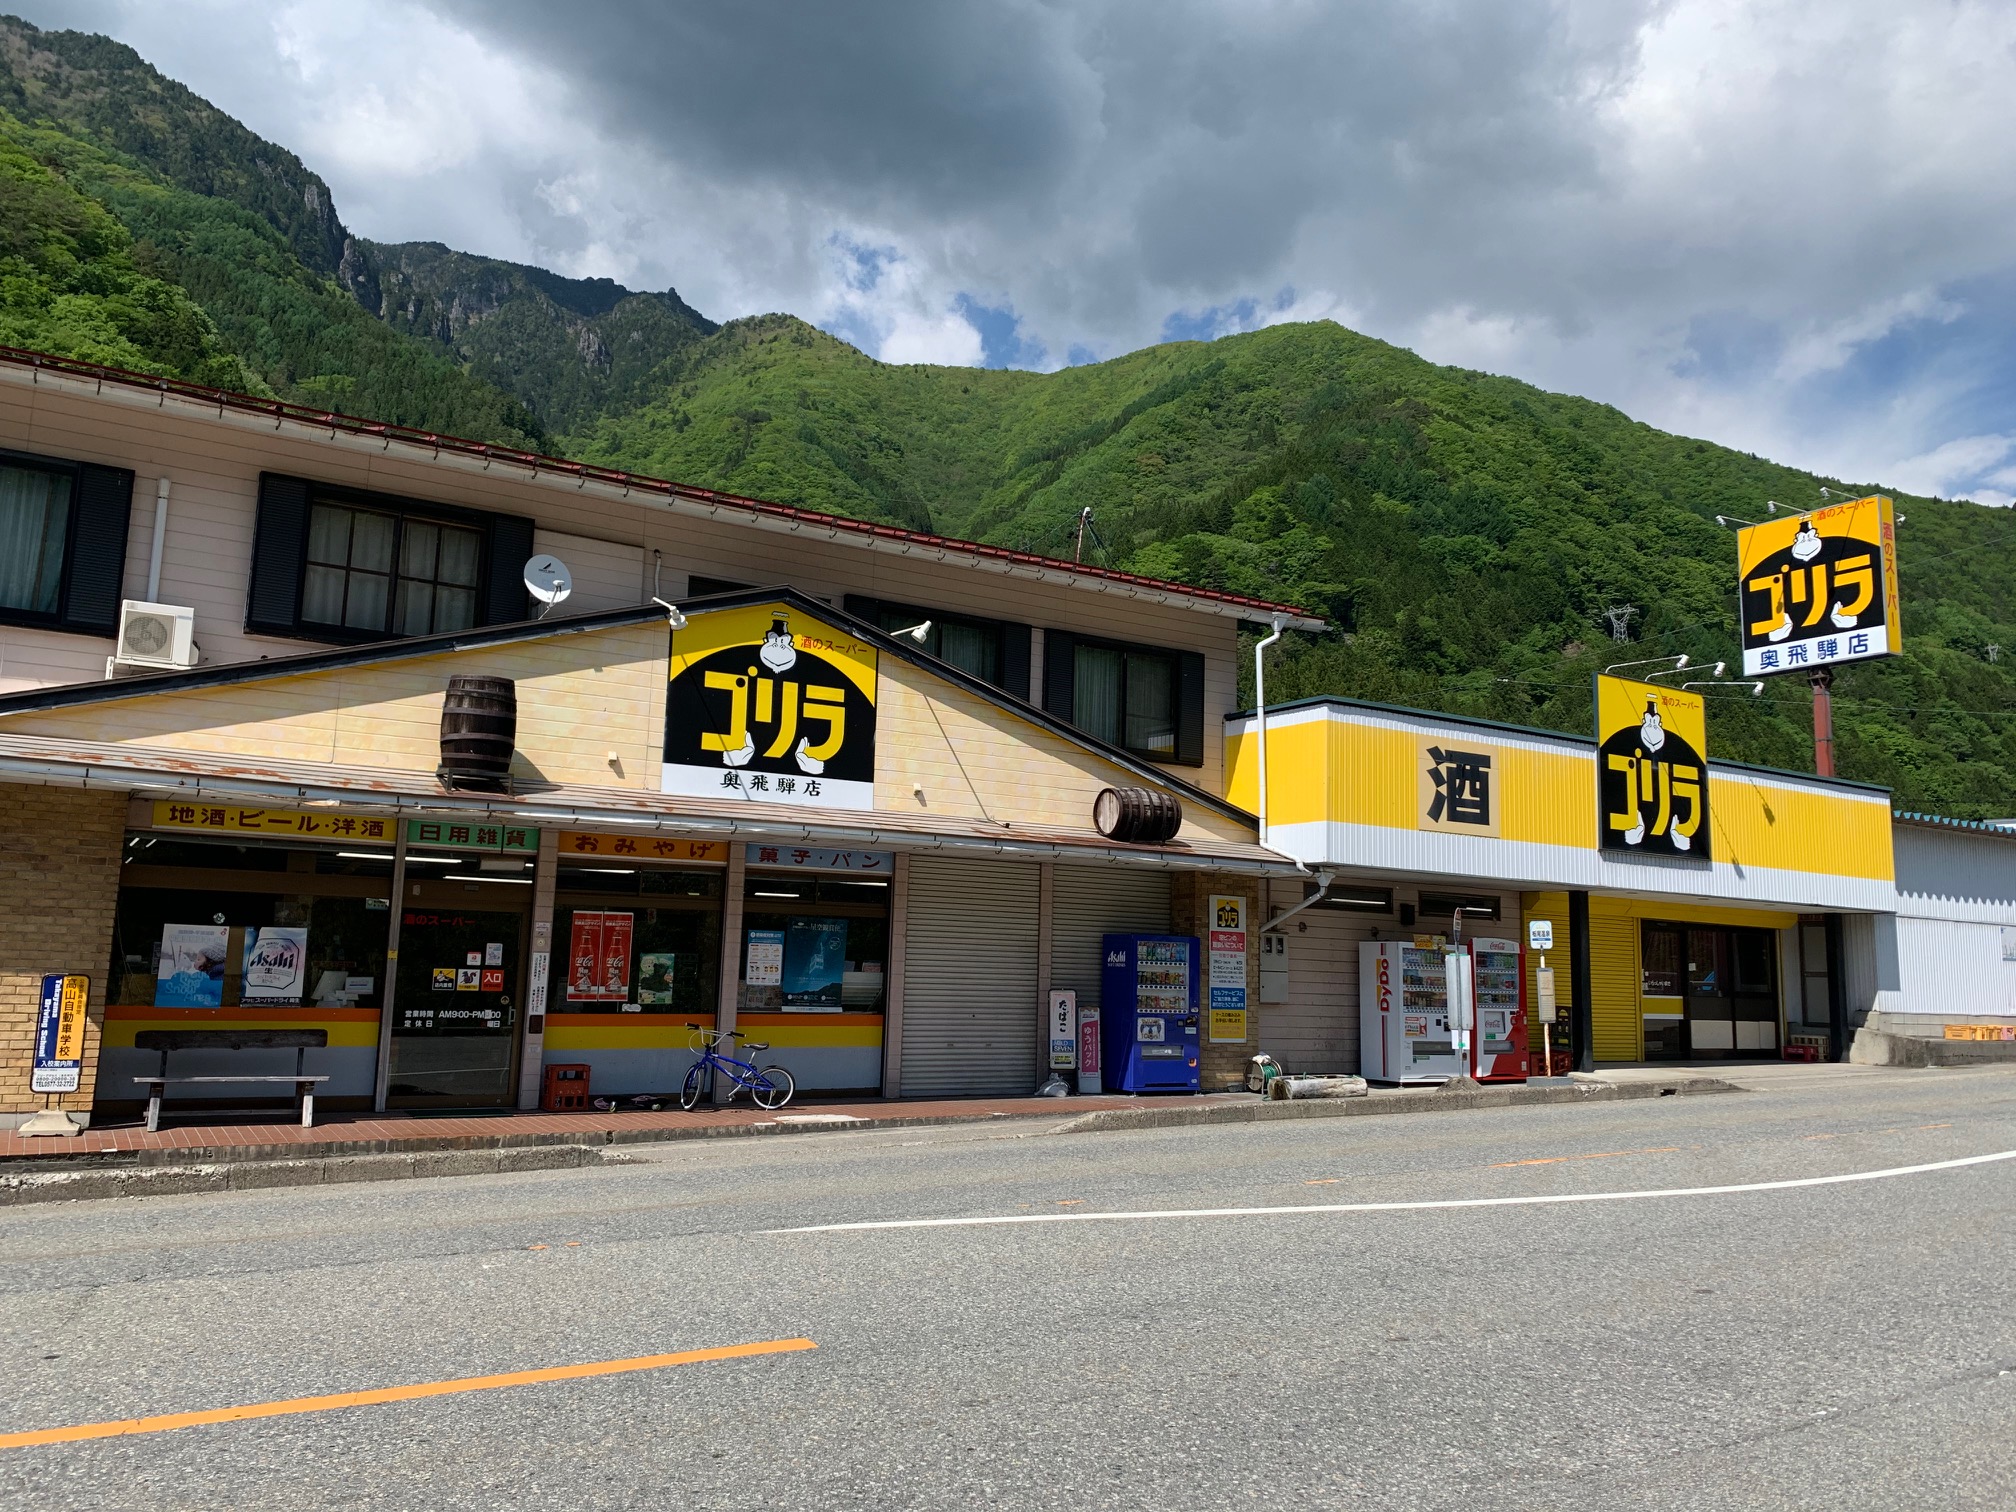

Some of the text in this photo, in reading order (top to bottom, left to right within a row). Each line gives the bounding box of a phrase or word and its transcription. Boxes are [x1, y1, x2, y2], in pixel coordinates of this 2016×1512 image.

[1816, 500, 1875, 521] 酒のスーパー
[1882, 522, 1899, 627] 酒のスーパー
[1749, 554, 1874, 636] ゴリラ
[800, 635, 867, 654] 酒のスーパー
[1760, 633, 1869, 670] 奥飛騨店
[701, 665, 846, 761] ゴリラ
[1661, 695, 1700, 710] 酒のスーパー
[720, 771, 822, 797] 奥飛騨店
[1426, 745, 1491, 826] 酒
[1608, 748, 1701, 837] ゴリラ
[419, 824, 527, 847] 日用雑貨
[574, 835, 715, 859] おみやげ
[250, 951, 294, 969] Asahi
[1107, 950, 1126, 963] Asahi
[483, 972, 501, 983] 入口
[1380, 958, 1392, 1012] DyDo
[52, 978, 63, 1018] Takayama
[41, 998, 52, 1028] Driving
[59, 978, 78, 1057] 高山自動車学校
[404, 1010, 434, 1018] 営業時間
[1058, 999, 1070, 1033] たばこ
[38, 1029, 48, 1057] School
[1084, 1026, 1092, 1067] ゆうパック
[40, 1060, 74, 1068] 入校案内所
